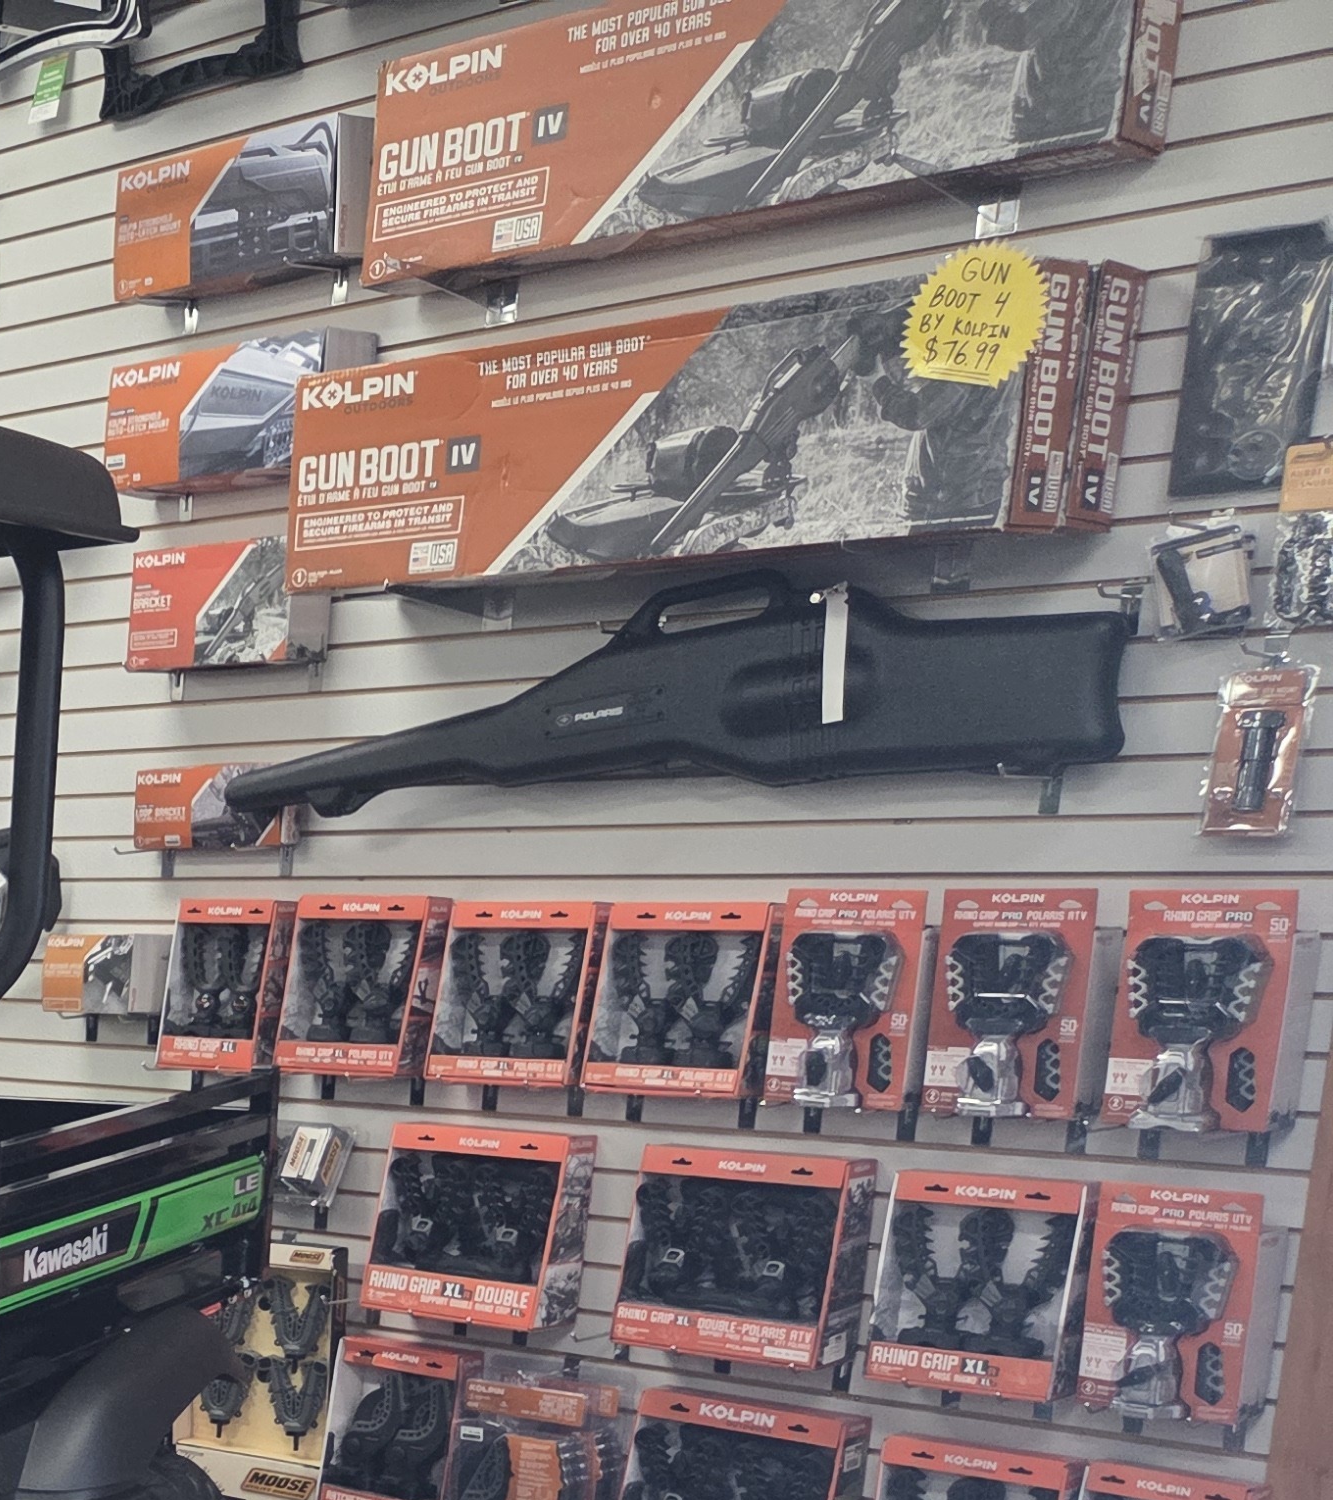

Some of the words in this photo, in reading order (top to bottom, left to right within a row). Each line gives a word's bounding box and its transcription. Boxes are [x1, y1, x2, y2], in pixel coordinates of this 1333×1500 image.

[568, 24, 588, 42] THE
[592, 15, 623, 36] MOST
[627, 2, 678, 28] POPULAR
[596, 36, 616, 54] FOR
[621, 27, 649, 48] OVER
[654, 22, 670, 39] 40
[676, 11, 712, 34] YEARS
[385, 44, 503, 96] KOLPIN
[379, 132, 439, 181] GUN
[442, 111, 526, 167] BOOT
[537, 111, 563, 138] IV
[121, 159, 190, 192] KOLPIN
[382, 211, 421, 228] SECURE
[423, 201, 474, 219] FIREARMS
[477, 197, 488, 206] IN
[492, 187, 537, 203] TRANSIT
[383, 197, 446, 218] ENGINEERED
[449, 191, 462, 203] TO
[465, 182, 512, 198] PROTECT
[516, 175, 538, 187] AND
[515, 216, 539, 241] USA
[961, 257, 1012, 285] GUN
[929, 284, 982, 313] BOOT
[995, 291, 1012, 318] 4
[1045, 273, 1070, 351] GUN
[919, 313, 945, 334] BY
[952, 316, 1011, 339] KOLPIN
[1067, 278, 1085, 380] KOLPIN
[1103, 277, 1131, 355] GUN
[478, 361, 498, 376] THE
[502, 354, 531, 373] MOST
[536, 346, 585, 367] POPULAR
[590, 343, 612, 358] GUN
[616, 336, 645, 355] BOOT
[924, 335, 1001, 371] $76.99
[112, 361, 180, 389] KOLPIN
[506, 374, 526, 390] FOR
[531, 368, 558, 386] OVER
[563, 365, 578, 381] 40
[583, 359, 618, 378] YEARS
[211, 385, 262, 402] KOLPIN
[302, 371, 414, 410] KOLPIN
[344, 399, 413, 415] OUTDOORS
[1032, 358, 1060, 462] BOOT
[1088, 360, 1119, 462] BOOT
[298, 450, 355, 493] GUN
[359, 438, 440, 485] BOOT
[451, 442, 476, 466] IV
[1028, 476, 1042, 506] IV
[1044, 478, 1060, 512] USA
[1084, 475, 1099, 504] IV
[303, 526, 340, 538] SECURE
[342, 519, 392, 534] FIREARMS
[394, 517, 405, 528] IN
[408, 513, 452, 526] TRANSIT
[304, 513, 364, 529] ENGINEERED
[367, 511, 380, 521] TO
[383, 506, 429, 519] PROTECT
[431, 502, 454, 513] AND
[136, 552, 185, 569] KOLPIN
[432, 542, 453, 566] USA
[133, 595, 172, 609] BRACKET
[574, 706, 623, 722] POLARIS
[137, 773, 181, 786] KOLPIN
[342, 902, 380, 914] KOLPIN
[829, 892, 879, 903] KOLPIN
[991, 893, 1045, 904] KOLPIN
[1181, 893, 1239, 904] KOLPIN
[207, 905, 242, 917] KOLPIN
[500, 908, 542, 920] KOLPIN
[665, 910, 712, 922] KOLPIN
[1163, 910, 1195, 922] RHINO
[1197, 911, 1221, 922] GRIP
[1225, 911, 1253, 922] PRO
[290, 1136, 306, 1167] MOOSE
[459, 1137, 500, 1149] KOLPIN
[718, 1160, 766, 1173] KOLPIN
[234, 1172, 260, 1195] LE
[954, 1185, 1017, 1200] KOLPIN
[1150, 1189, 1210, 1204] KOLPIN
[201, 1207, 230, 1233] XC
[1162, 1207, 1184, 1218] PRO
[1189, 1209, 1229, 1222] POLARIS
[1233, 1212, 1253, 1224] UTV
[23, 1223, 108, 1283] Kawasaki
[369, 1270, 407, 1291] RHINO
[409, 1274, 440, 1294] GRIP
[443, 1282, 462, 1298] XL
[474, 1285, 530, 1309] DOUBLE
[617, 1305, 647, 1321] RHINO
[651, 1309, 674, 1324] GRIP
[676, 1315, 689, 1327] XL
[697, 1317, 787, 1340] DOUBLE-POLARIS
[790, 1328, 813, 1342] ATV
[381, 1350, 420, 1365] KOLPIN
[871, 1345, 919, 1367] RHINO
[921, 1353, 959, 1370] GRIP
[963, 1358, 987, 1375] XL
[468, 1383, 505, 1396] KOLPIN
[699, 1403, 776, 1428] KOLPIN
[944, 1453, 997, 1471] KOLPIN
[249, 1470, 313, 1493] MOOSE
[1136, 1479, 1192, 1497] KOLPIN
